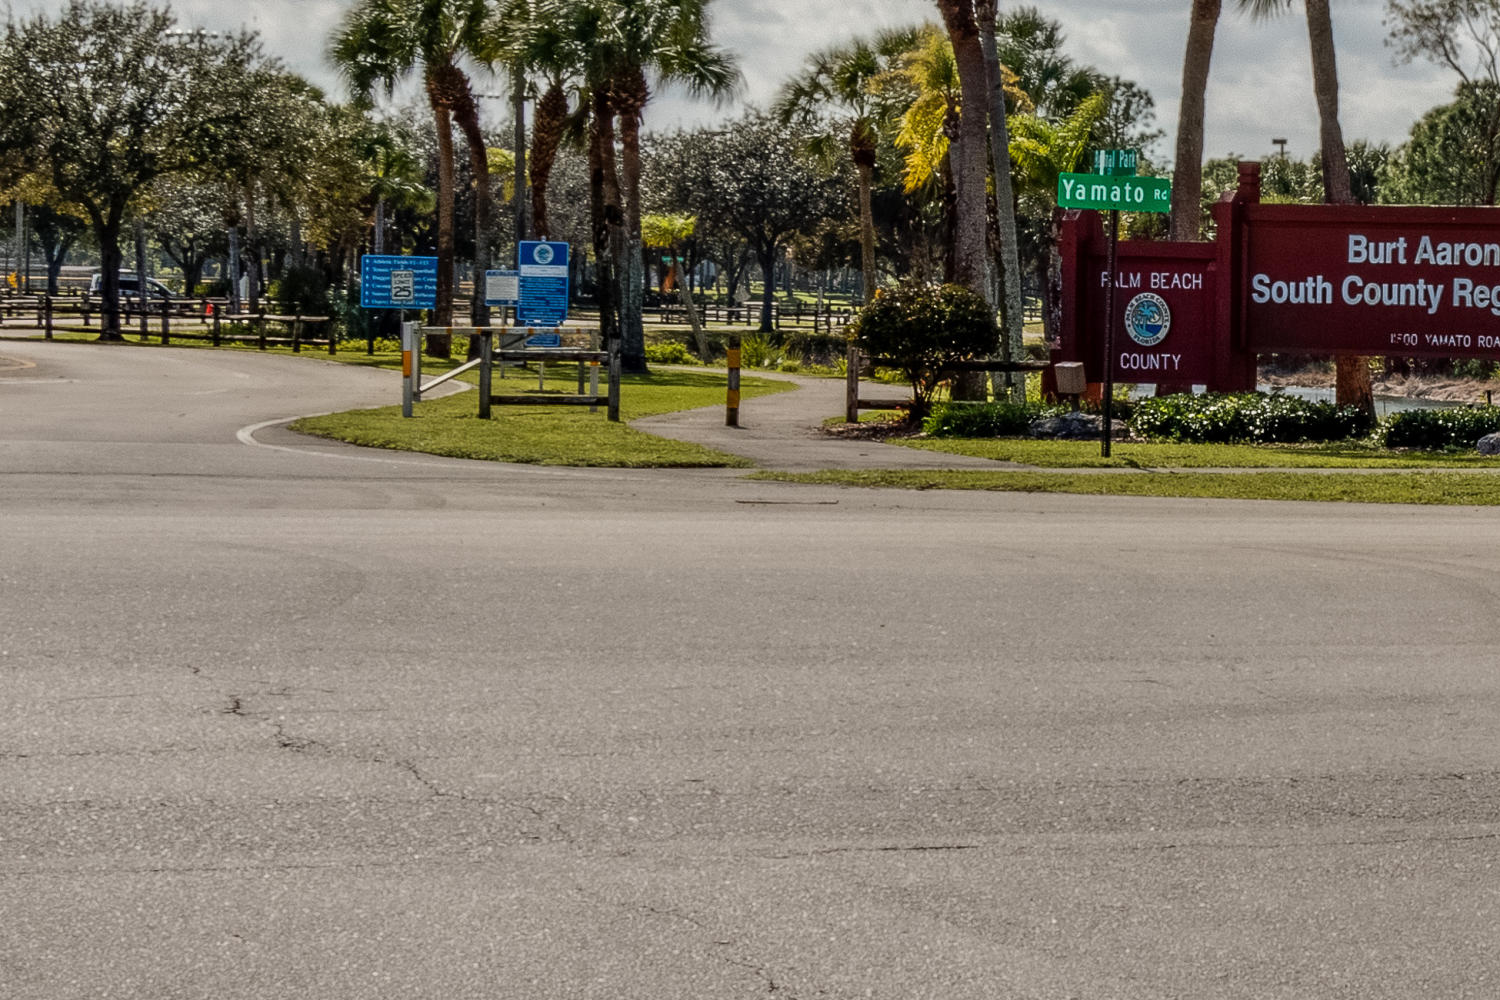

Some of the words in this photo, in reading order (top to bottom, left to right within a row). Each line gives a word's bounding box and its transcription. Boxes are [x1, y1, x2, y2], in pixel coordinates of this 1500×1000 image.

[1119, 150, 1136, 168] Park
[1062, 179, 1144, 203] Yamato
[1348, 234, 1407, 264] Burt
[1100, 271, 1141, 288] PLM
[1150, 272, 1202, 290] BEACH
[393, 286, 412, 298] 25
[1251, 273, 1333, 304] South
[1341, 275, 1444, 315] County
[1425, 334, 1471, 348] YAMATO
[1120, 353, 1182, 370] COUNTY
